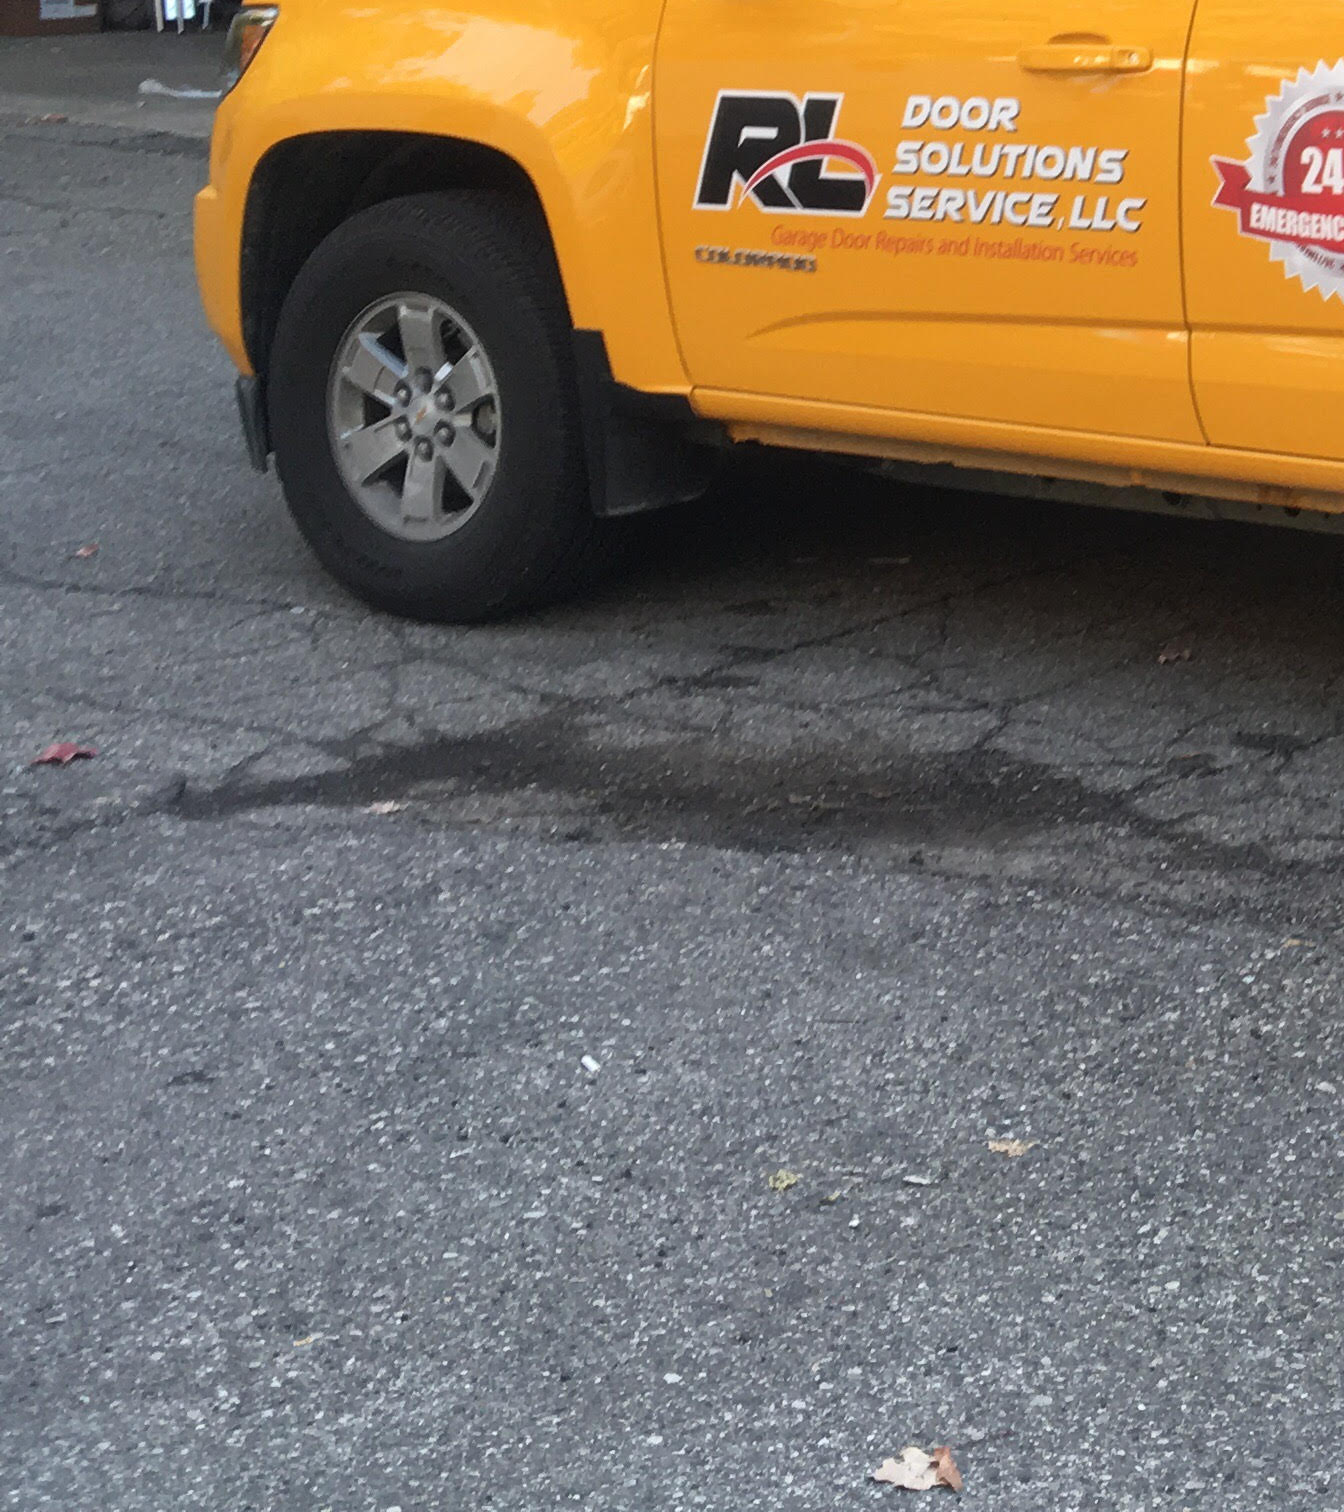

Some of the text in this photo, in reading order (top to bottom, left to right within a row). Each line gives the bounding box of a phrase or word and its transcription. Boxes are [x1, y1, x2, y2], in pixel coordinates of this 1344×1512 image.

[902, 95, 1020, 131] DOOR
[692, 89, 882, 217] RL
[892, 140, 1129, 184] SOLUTIONS
[771, 224, 1138, 268] Garage Door Repairs and Installation Services
